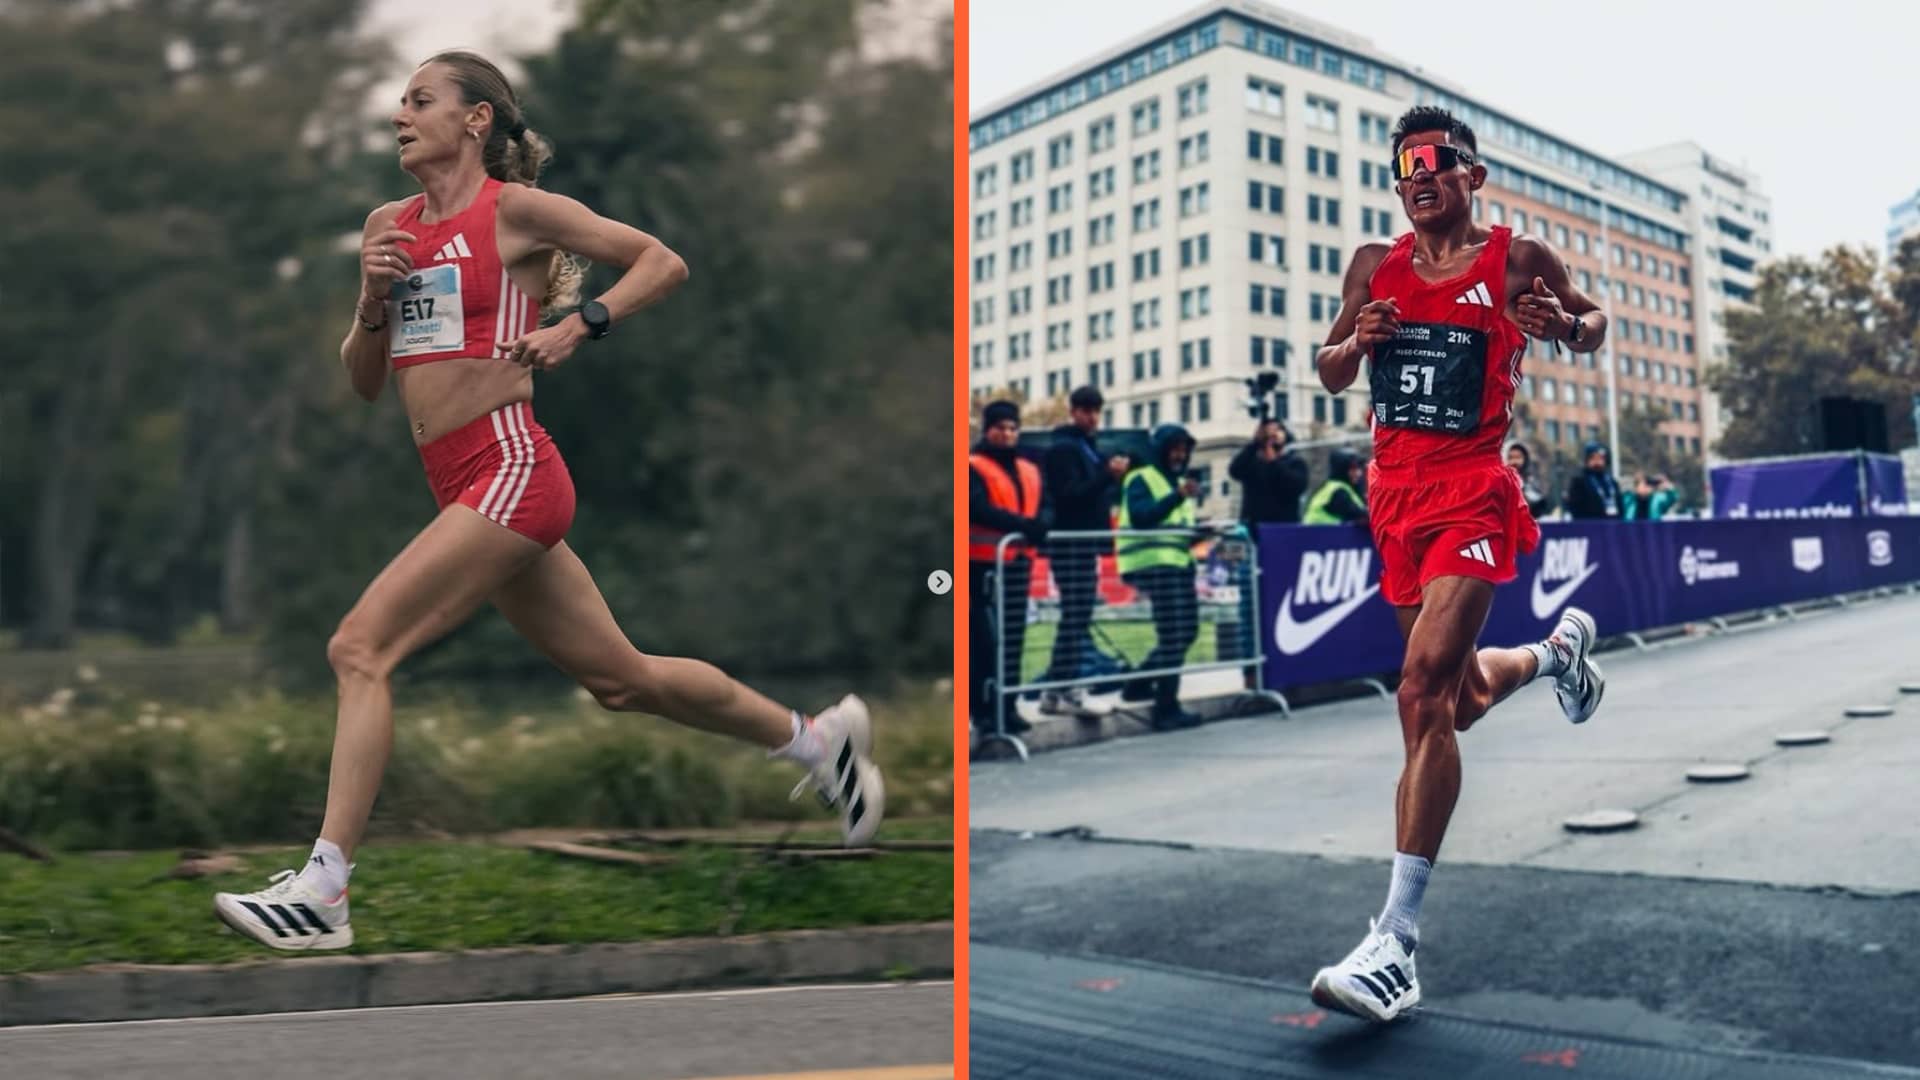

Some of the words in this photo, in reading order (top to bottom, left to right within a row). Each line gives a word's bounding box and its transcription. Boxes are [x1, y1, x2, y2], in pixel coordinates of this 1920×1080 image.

[402, 298, 435, 321] E17
[1447, 331, 1473, 345] 21K
[1400, 363, 1436, 396] 51
[1542, 537, 1589, 582] RUN
[1294, 548, 1372, 606] RUN
